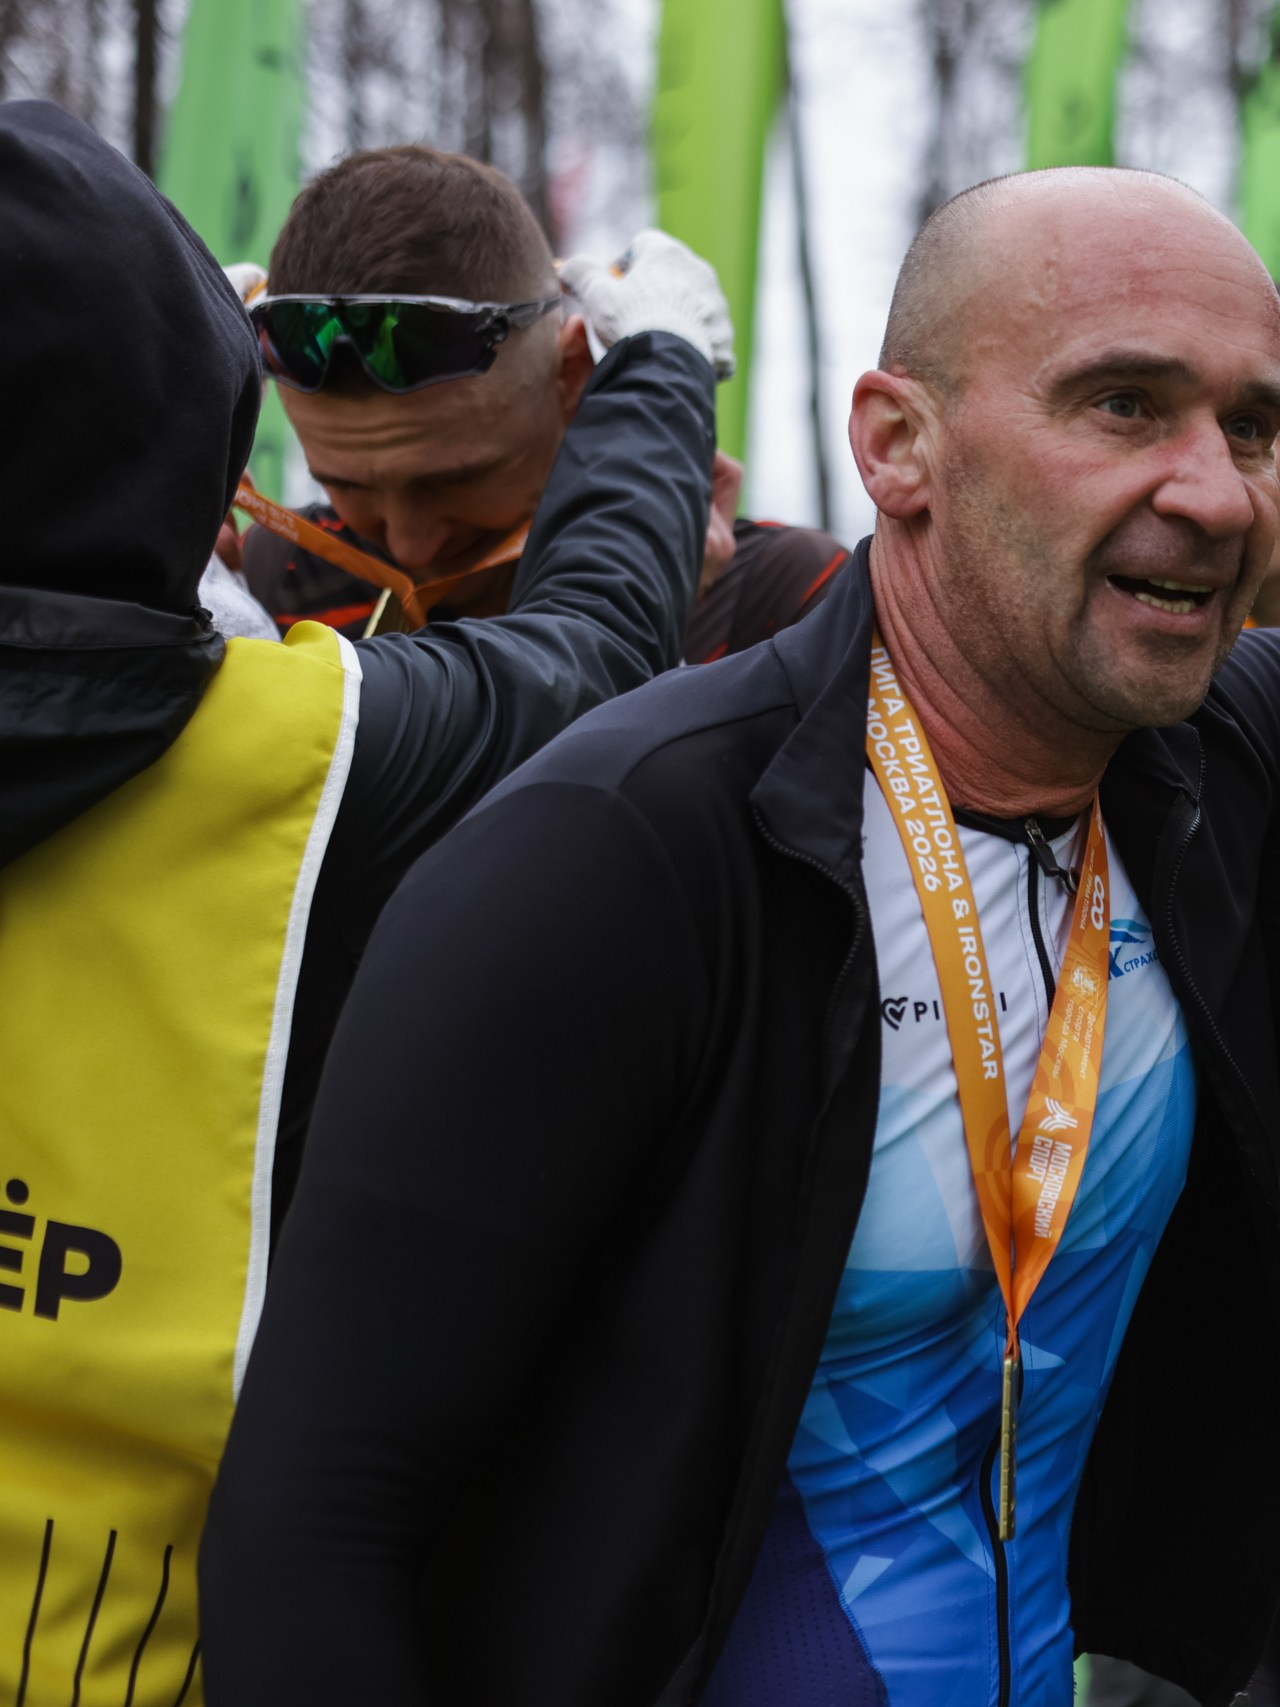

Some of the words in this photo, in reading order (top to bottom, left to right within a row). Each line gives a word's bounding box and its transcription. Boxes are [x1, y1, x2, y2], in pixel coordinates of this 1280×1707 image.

[867, 698, 917, 815] МОСКВА
[905, 819, 943, 893] 2026
[894, 718, 963, 892] ТРИАТЛОНА
[952, 898, 970, 920] &
[957, 926, 999, 1080] IRONSTAR
[1026, 1135, 1054, 1184] СПОРТ
[1034, 1141, 1073, 1239] МОСКОВСКИЙ
